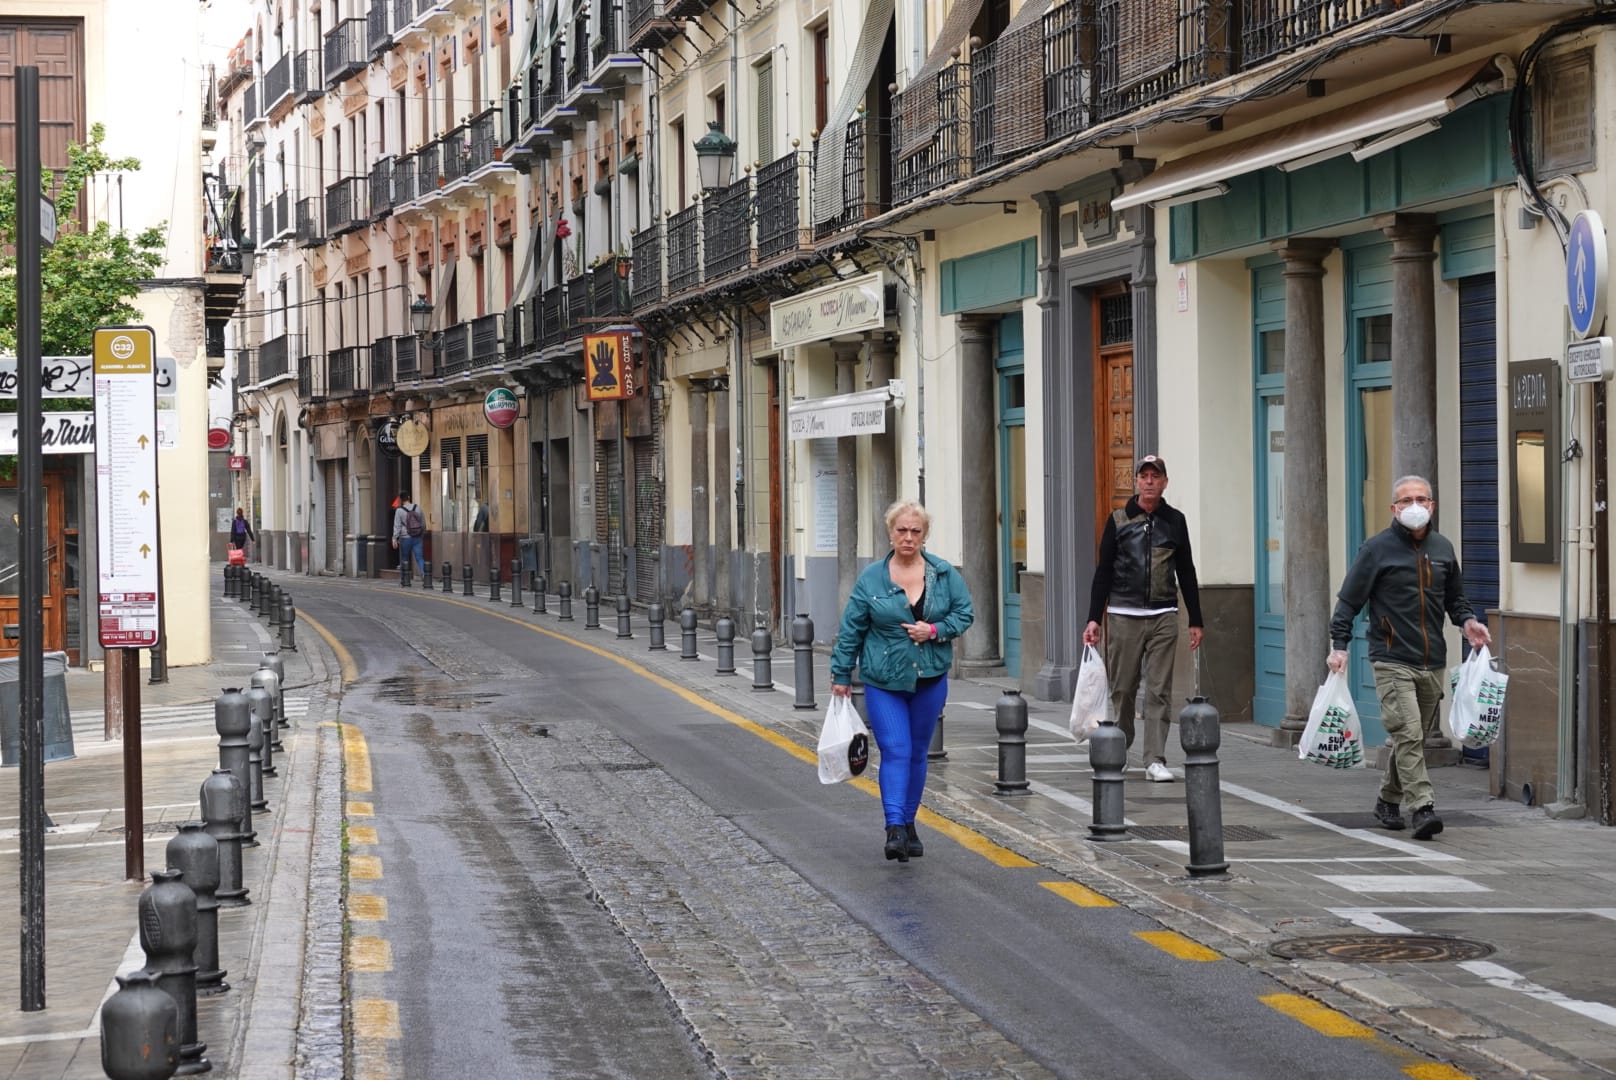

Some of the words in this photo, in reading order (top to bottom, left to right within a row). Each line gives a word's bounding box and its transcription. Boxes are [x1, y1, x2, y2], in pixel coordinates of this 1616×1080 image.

[622, 335, 631, 363] HECHO
[624, 372, 634, 396] MANO
[1521, 373, 1547, 409] PEPITA
[1318, 742, 1340, 752] MER
